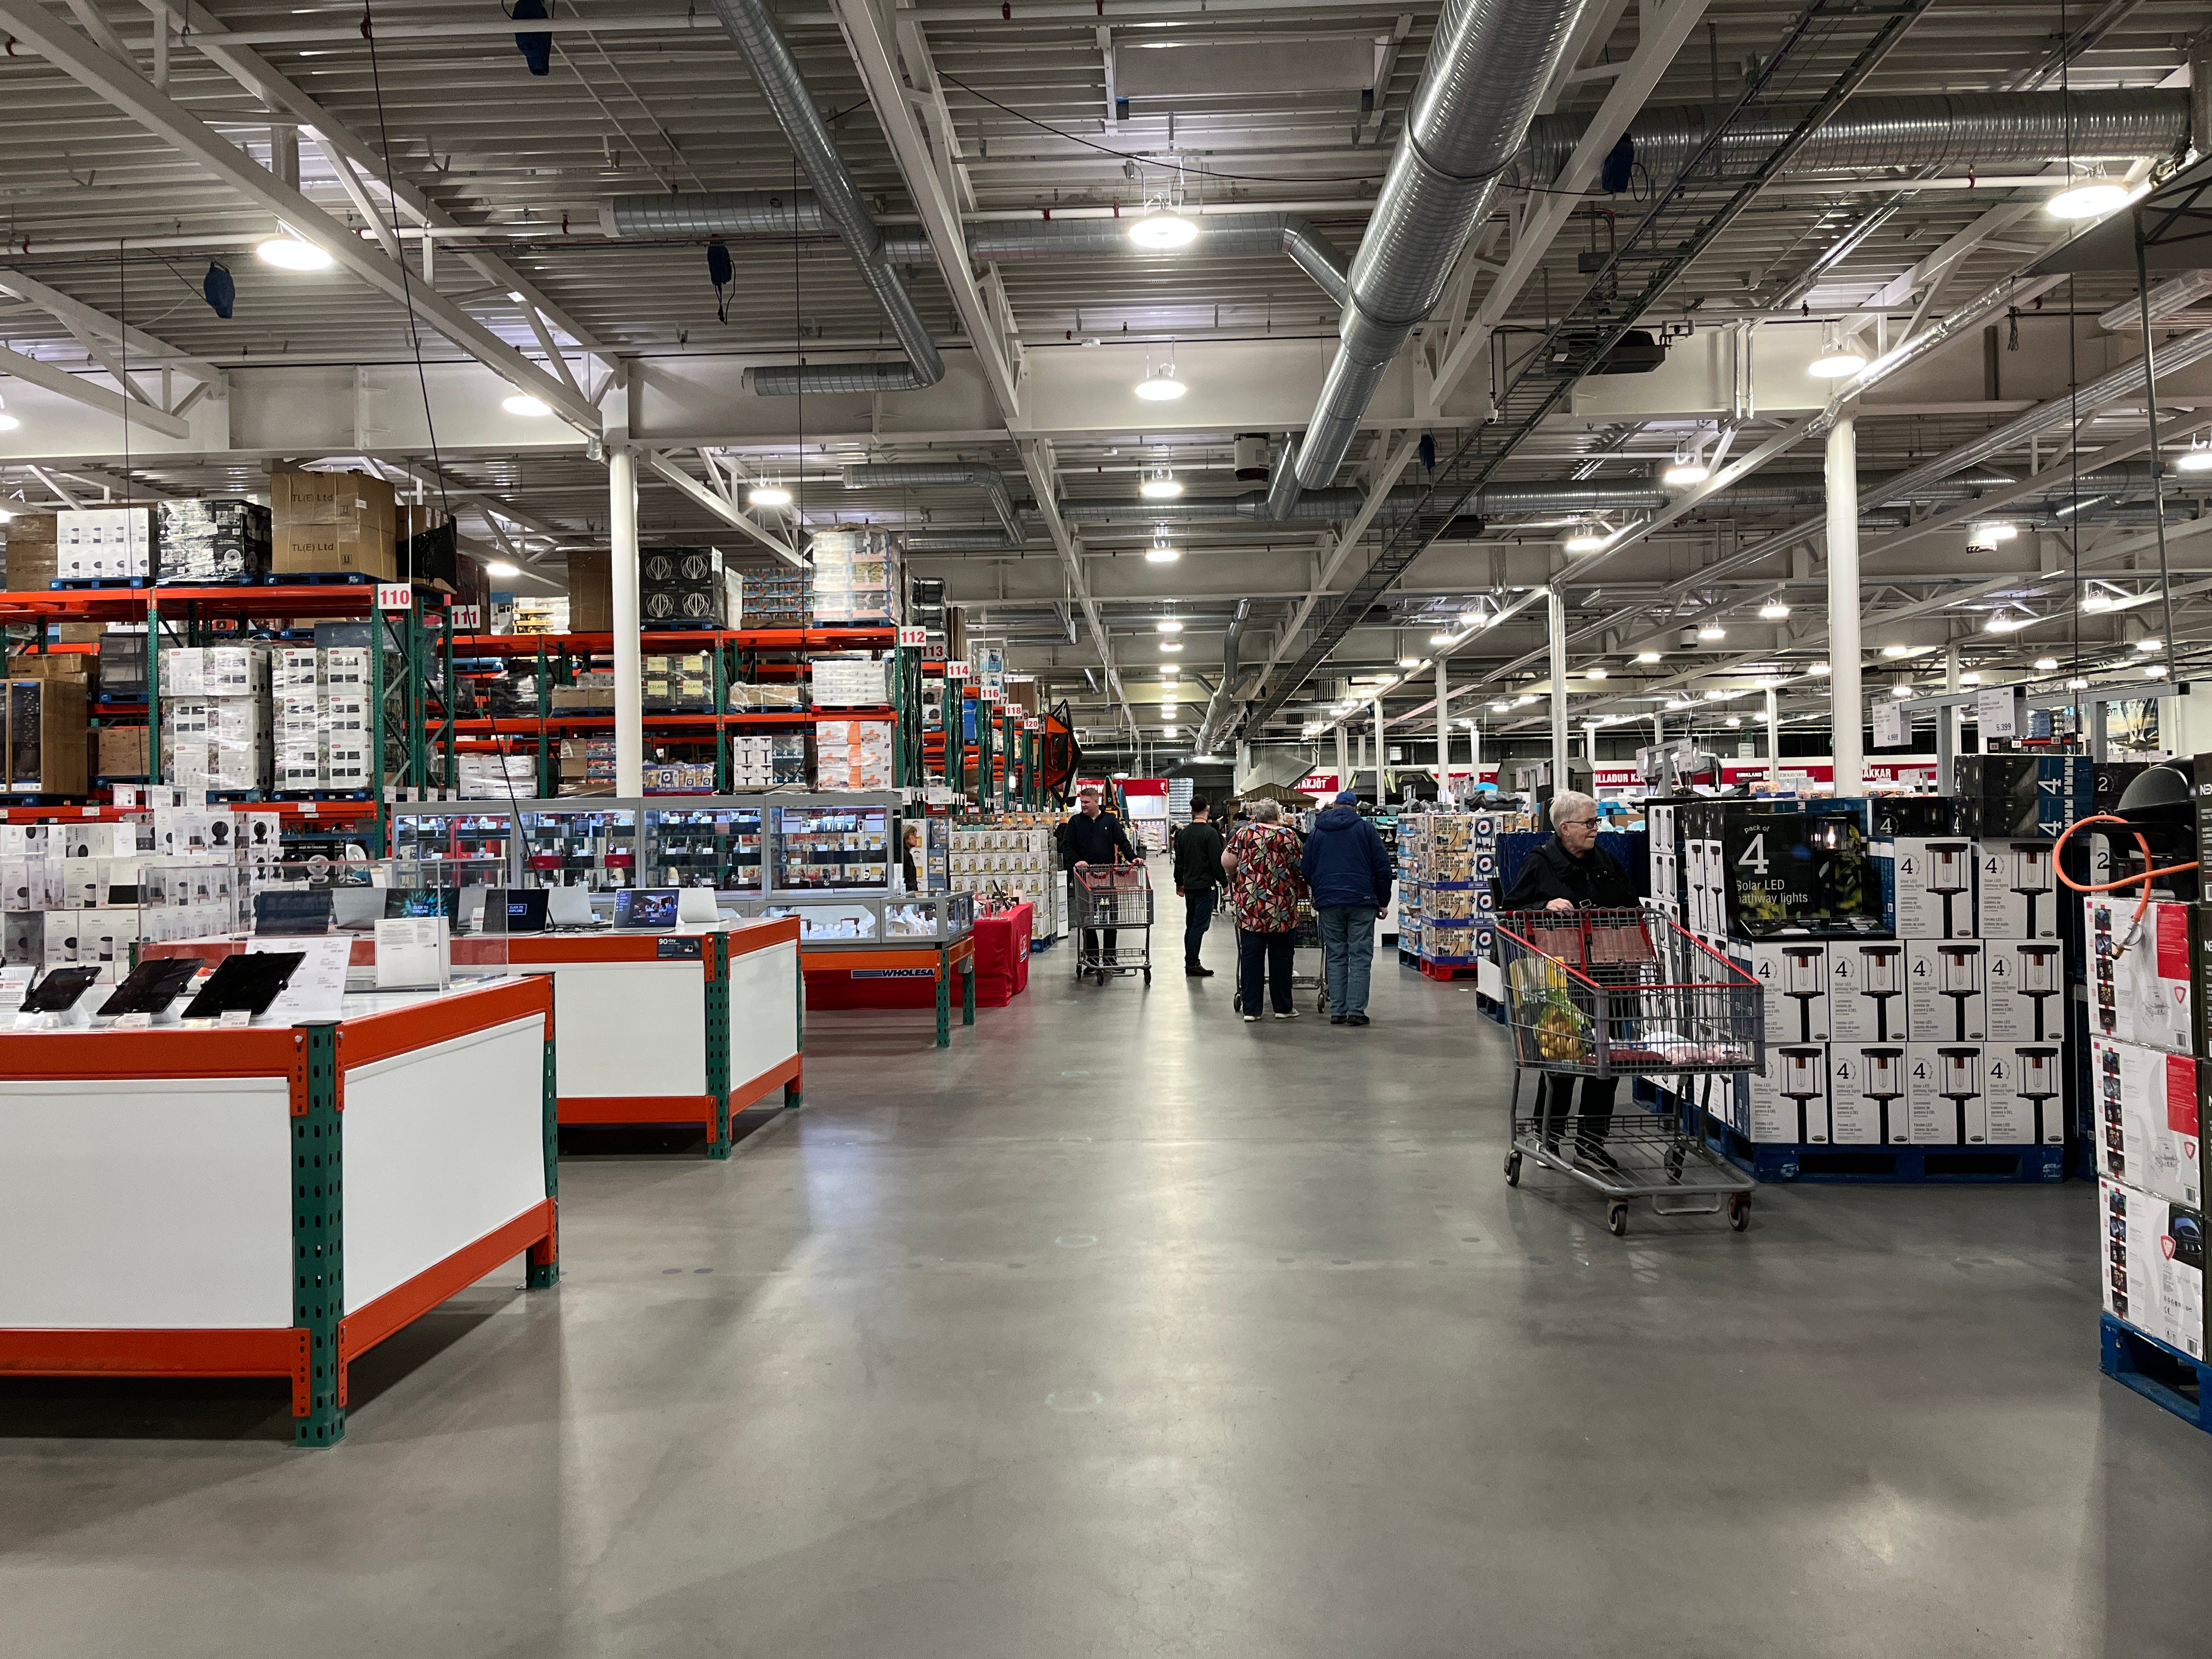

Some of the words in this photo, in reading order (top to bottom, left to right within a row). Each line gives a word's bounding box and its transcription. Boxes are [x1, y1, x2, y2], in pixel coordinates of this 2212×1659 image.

[292, 544, 315, 552] TL(E)
[380, 590, 409, 605] 110
[452, 611, 476, 624] 111
[901, 631, 924, 643] 112
[922, 646, 943, 657] 113
[949, 665, 969, 675] 114
[964, 676, 981, 685] 115
[982, 689, 999, 698] 116
[1996, 723, 2011, 731] 5.399
[1862, 769, 1891, 778] AKKAR
[1955, 776, 1961, 792] 4
[2038, 778, 2062, 794] 4
[2097, 777, 2108, 792] 2
[1685, 822, 1689, 837] 4
[1706, 821, 1710, 837] 4
[1743, 825, 1761, 833] pack
[1880, 817, 1892, 833] 4
[1954, 816, 1960, 833] 4
[2039, 820, 2062, 837] 4
[1738, 833, 1769, 874] 4
[2097, 852, 2108, 869] 2
[1900, 858, 1913, 874] 4
[1985, 857, 1997, 873] 4
[1737, 880, 1761, 890] Solar
[1765, 879, 1785, 890] LED
[1781, 893, 1808, 905] lights
[1758, 962, 1770, 978] 4
[1835, 961, 1847, 977] 4
[1913, 960, 1925, 977] 4
[1992, 960, 2004, 975] 4
[1837, 1063, 1849, 1079] 4
[1913, 1063, 1925, 1079] 4
[1990, 1062, 2003, 1079] 4
